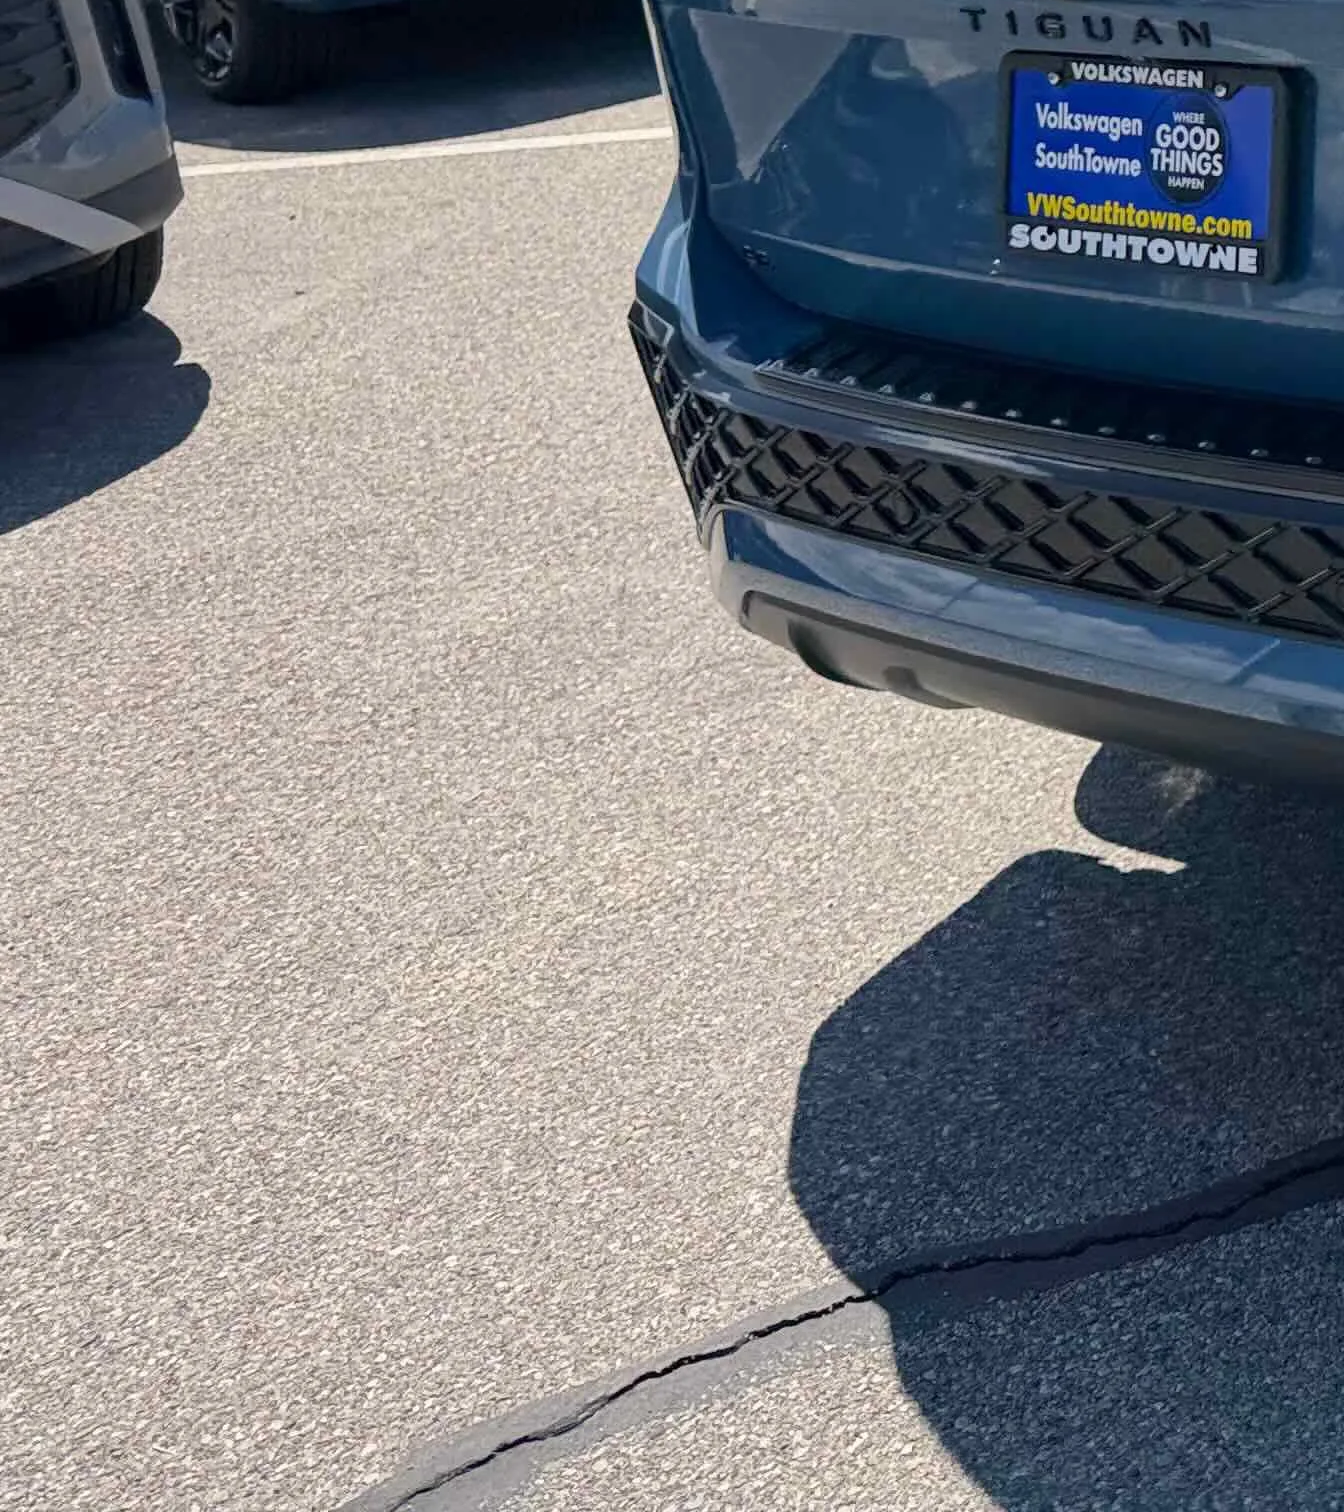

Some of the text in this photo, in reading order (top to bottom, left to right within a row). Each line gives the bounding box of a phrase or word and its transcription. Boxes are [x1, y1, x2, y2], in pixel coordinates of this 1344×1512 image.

[960, 7, 1212, 48] TIGUAN
[1071, 62, 1204, 89] VOLKSWAGEN
[1035, 102, 1143, 142] Volkswagen
[1172, 111, 1205, 124] WHERE
[1155, 123, 1220, 152] GOOD
[1034, 142, 1142, 177] SouthTowne
[1150, 148, 1223, 177] THINGS
[1167, 176, 1205, 191] HAPPEN
[1027, 191, 1253, 240] VWSouthtowne.com
[1008, 223, 1259, 275] SOUTHTOWNE
